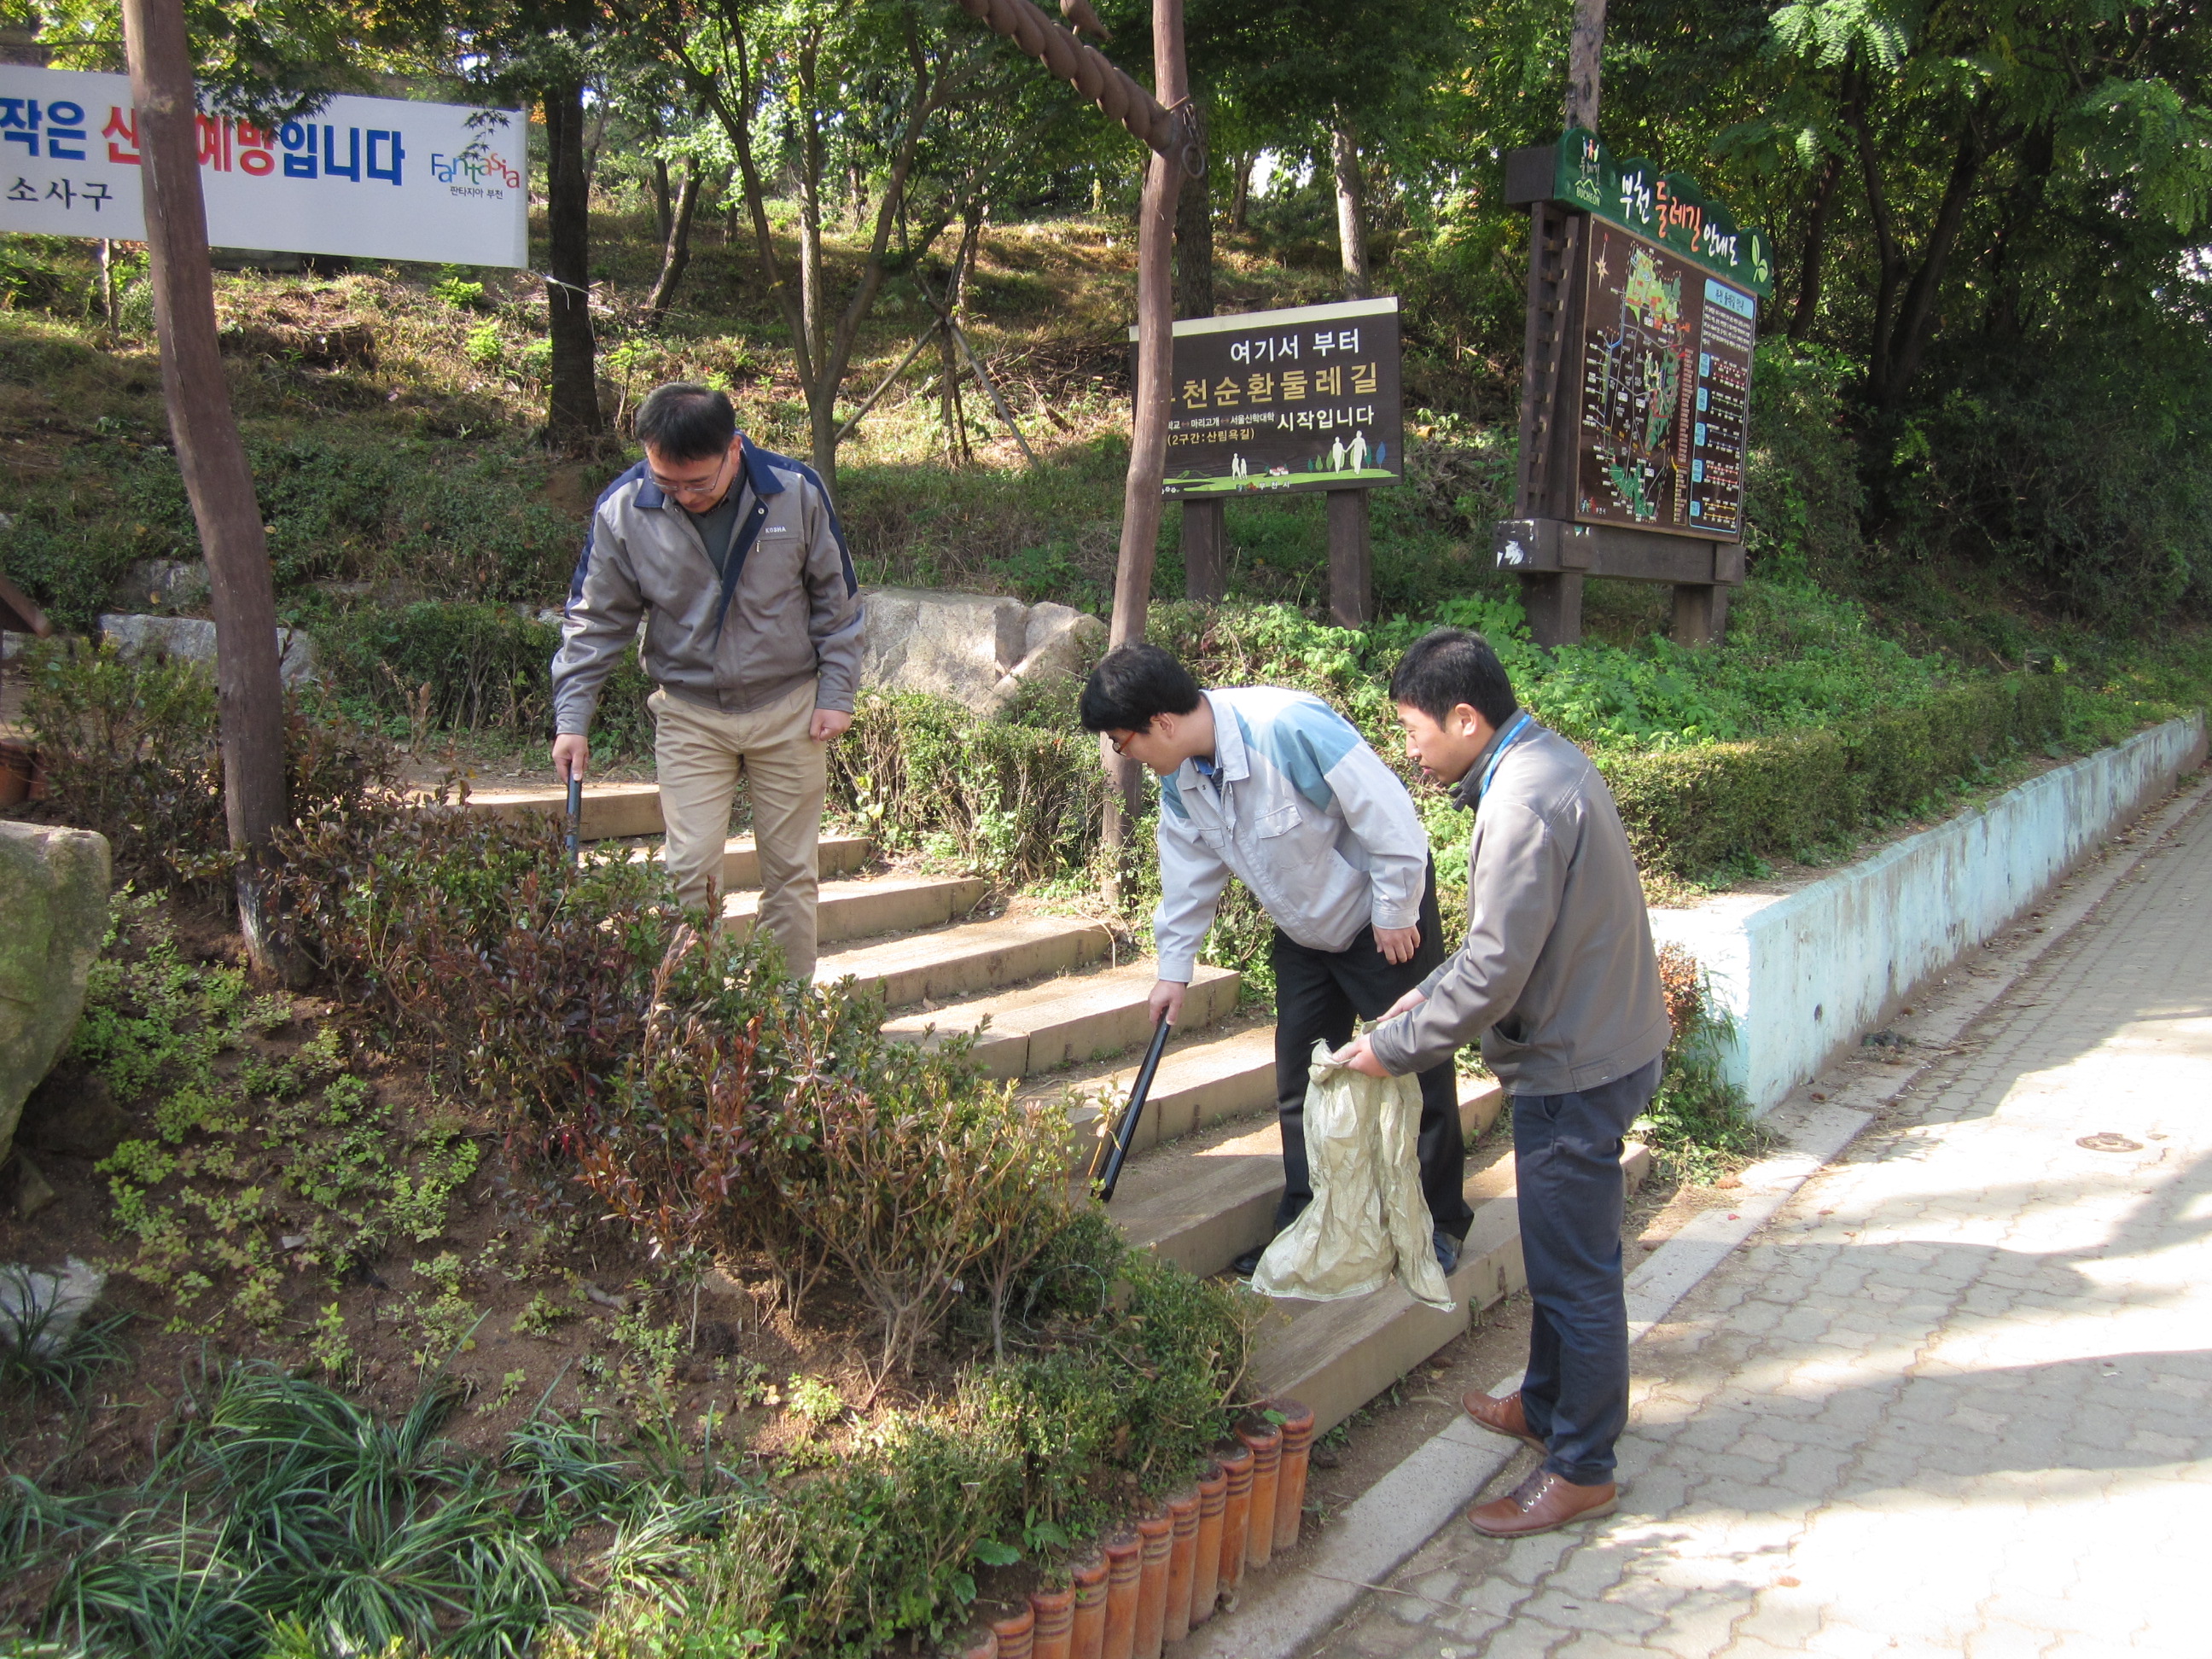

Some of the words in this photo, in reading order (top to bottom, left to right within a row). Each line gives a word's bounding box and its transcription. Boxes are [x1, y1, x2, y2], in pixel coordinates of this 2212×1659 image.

[0, 98, 86, 160] 작은
[102, 106, 405, 186] 산예방입니다
[431, 153, 520, 188] Fantasia
[7, 177, 114, 212] 소사구
[450, 186, 484, 198] 판타지아
[486, 189, 504, 200] 부천
[1576, 185, 1601, 207] BUCHEON
[1620, 171, 1650, 224] 부천
[1655, 181, 1702, 252] 둘레길
[1703, 224, 1738, 267] 안내도
[1231, 335, 1299, 364] 여기서
[1313, 328, 1359, 357] 부터
[1171, 362, 1377, 409] 천순환둘레길
[1230, 411, 1275, 425] 서울신학대학
[1277, 405, 1375, 432] 시작입니다
